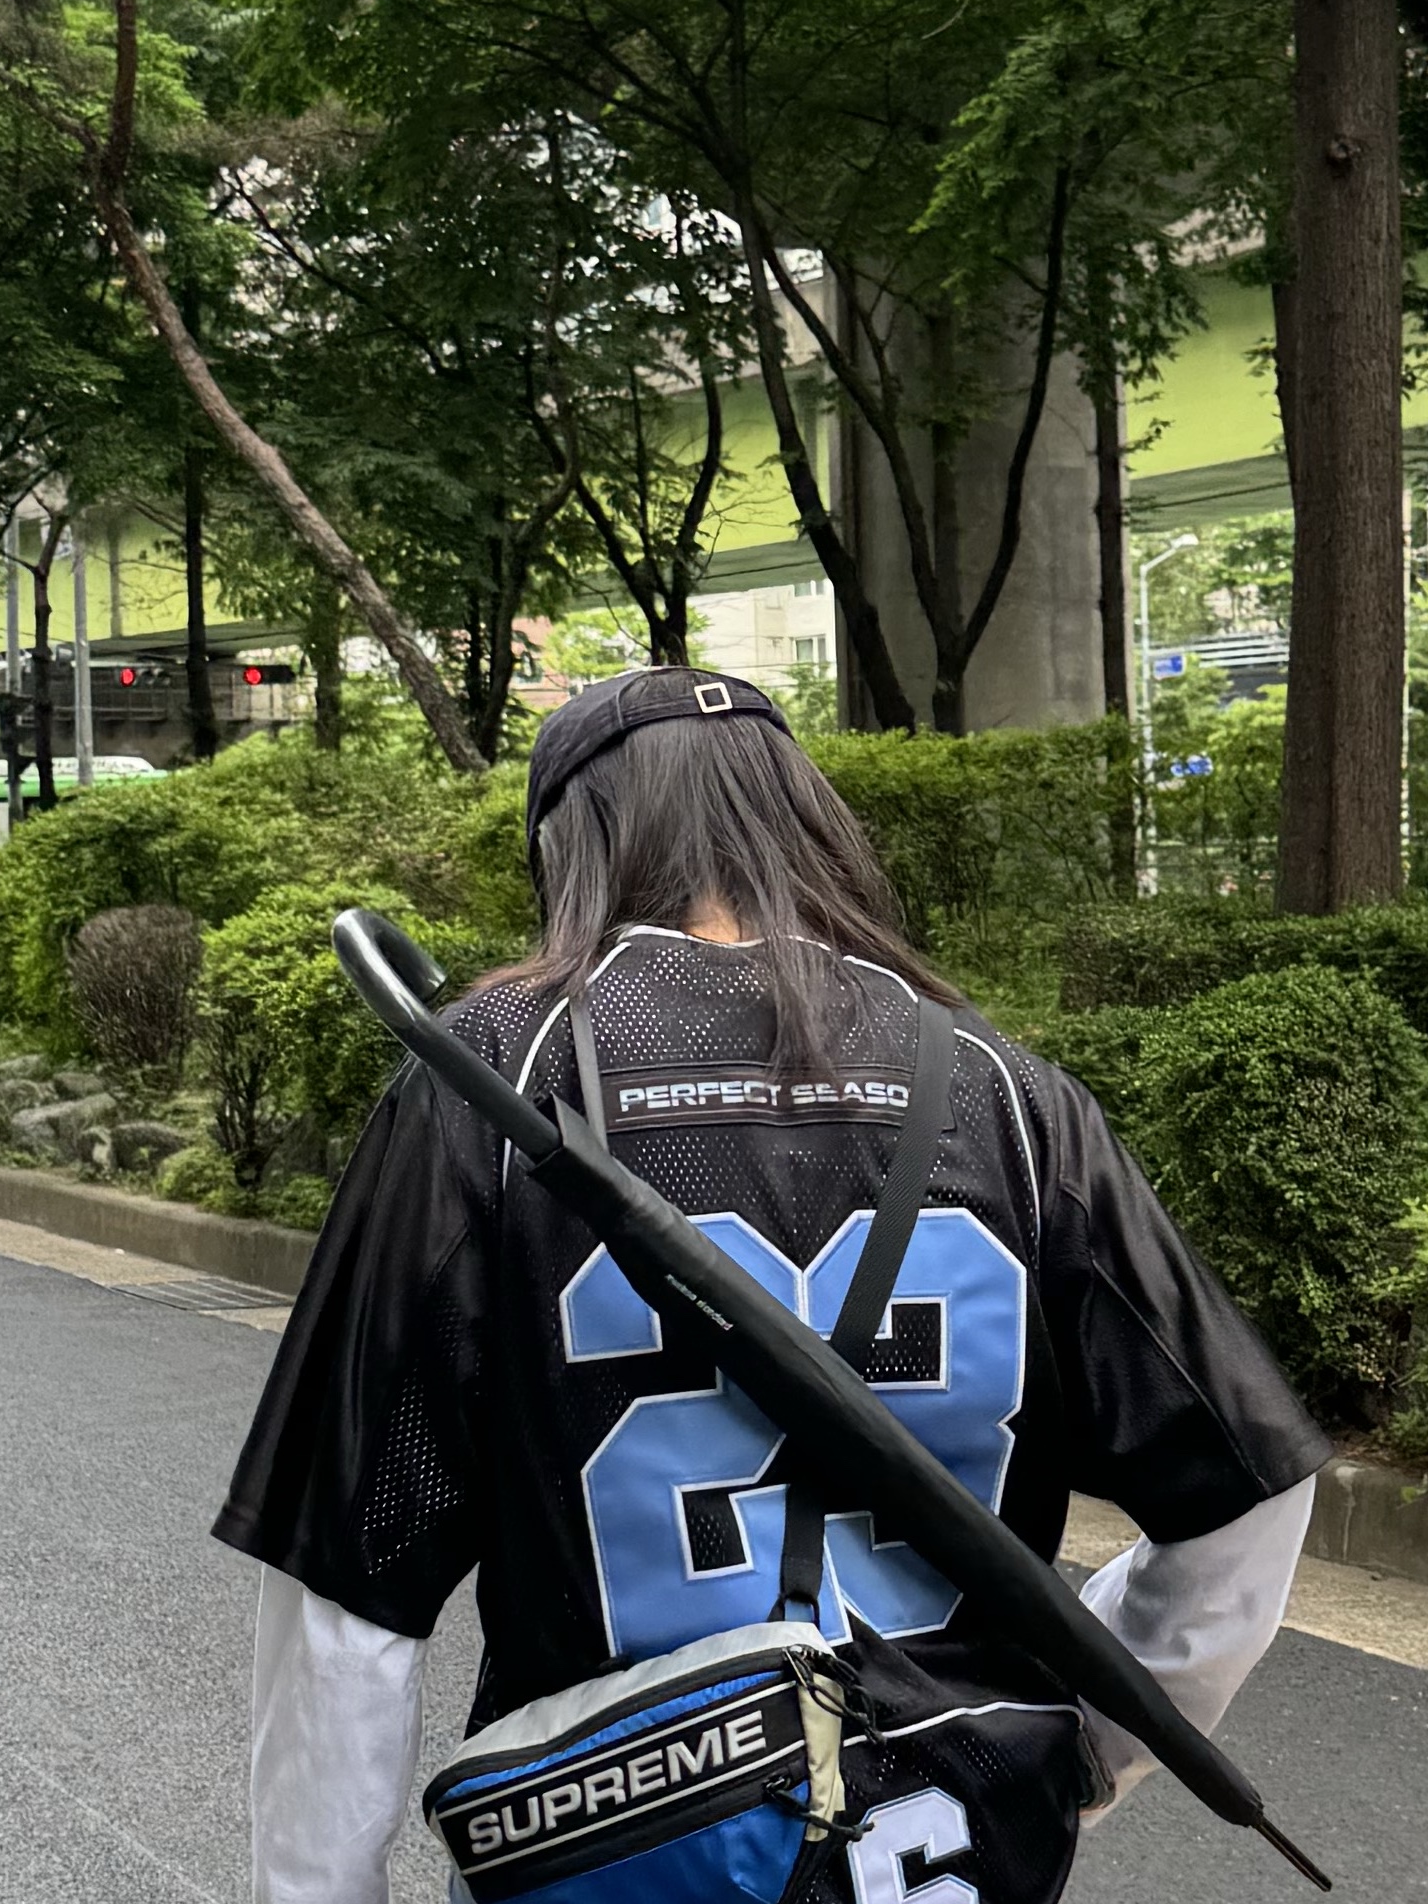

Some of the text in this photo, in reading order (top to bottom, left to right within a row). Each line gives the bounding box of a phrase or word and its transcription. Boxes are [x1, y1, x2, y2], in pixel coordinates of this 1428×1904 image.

[619, 1080, 911, 1112] PERFECT SEASO
[468, 1709, 768, 1855] SUPREME
